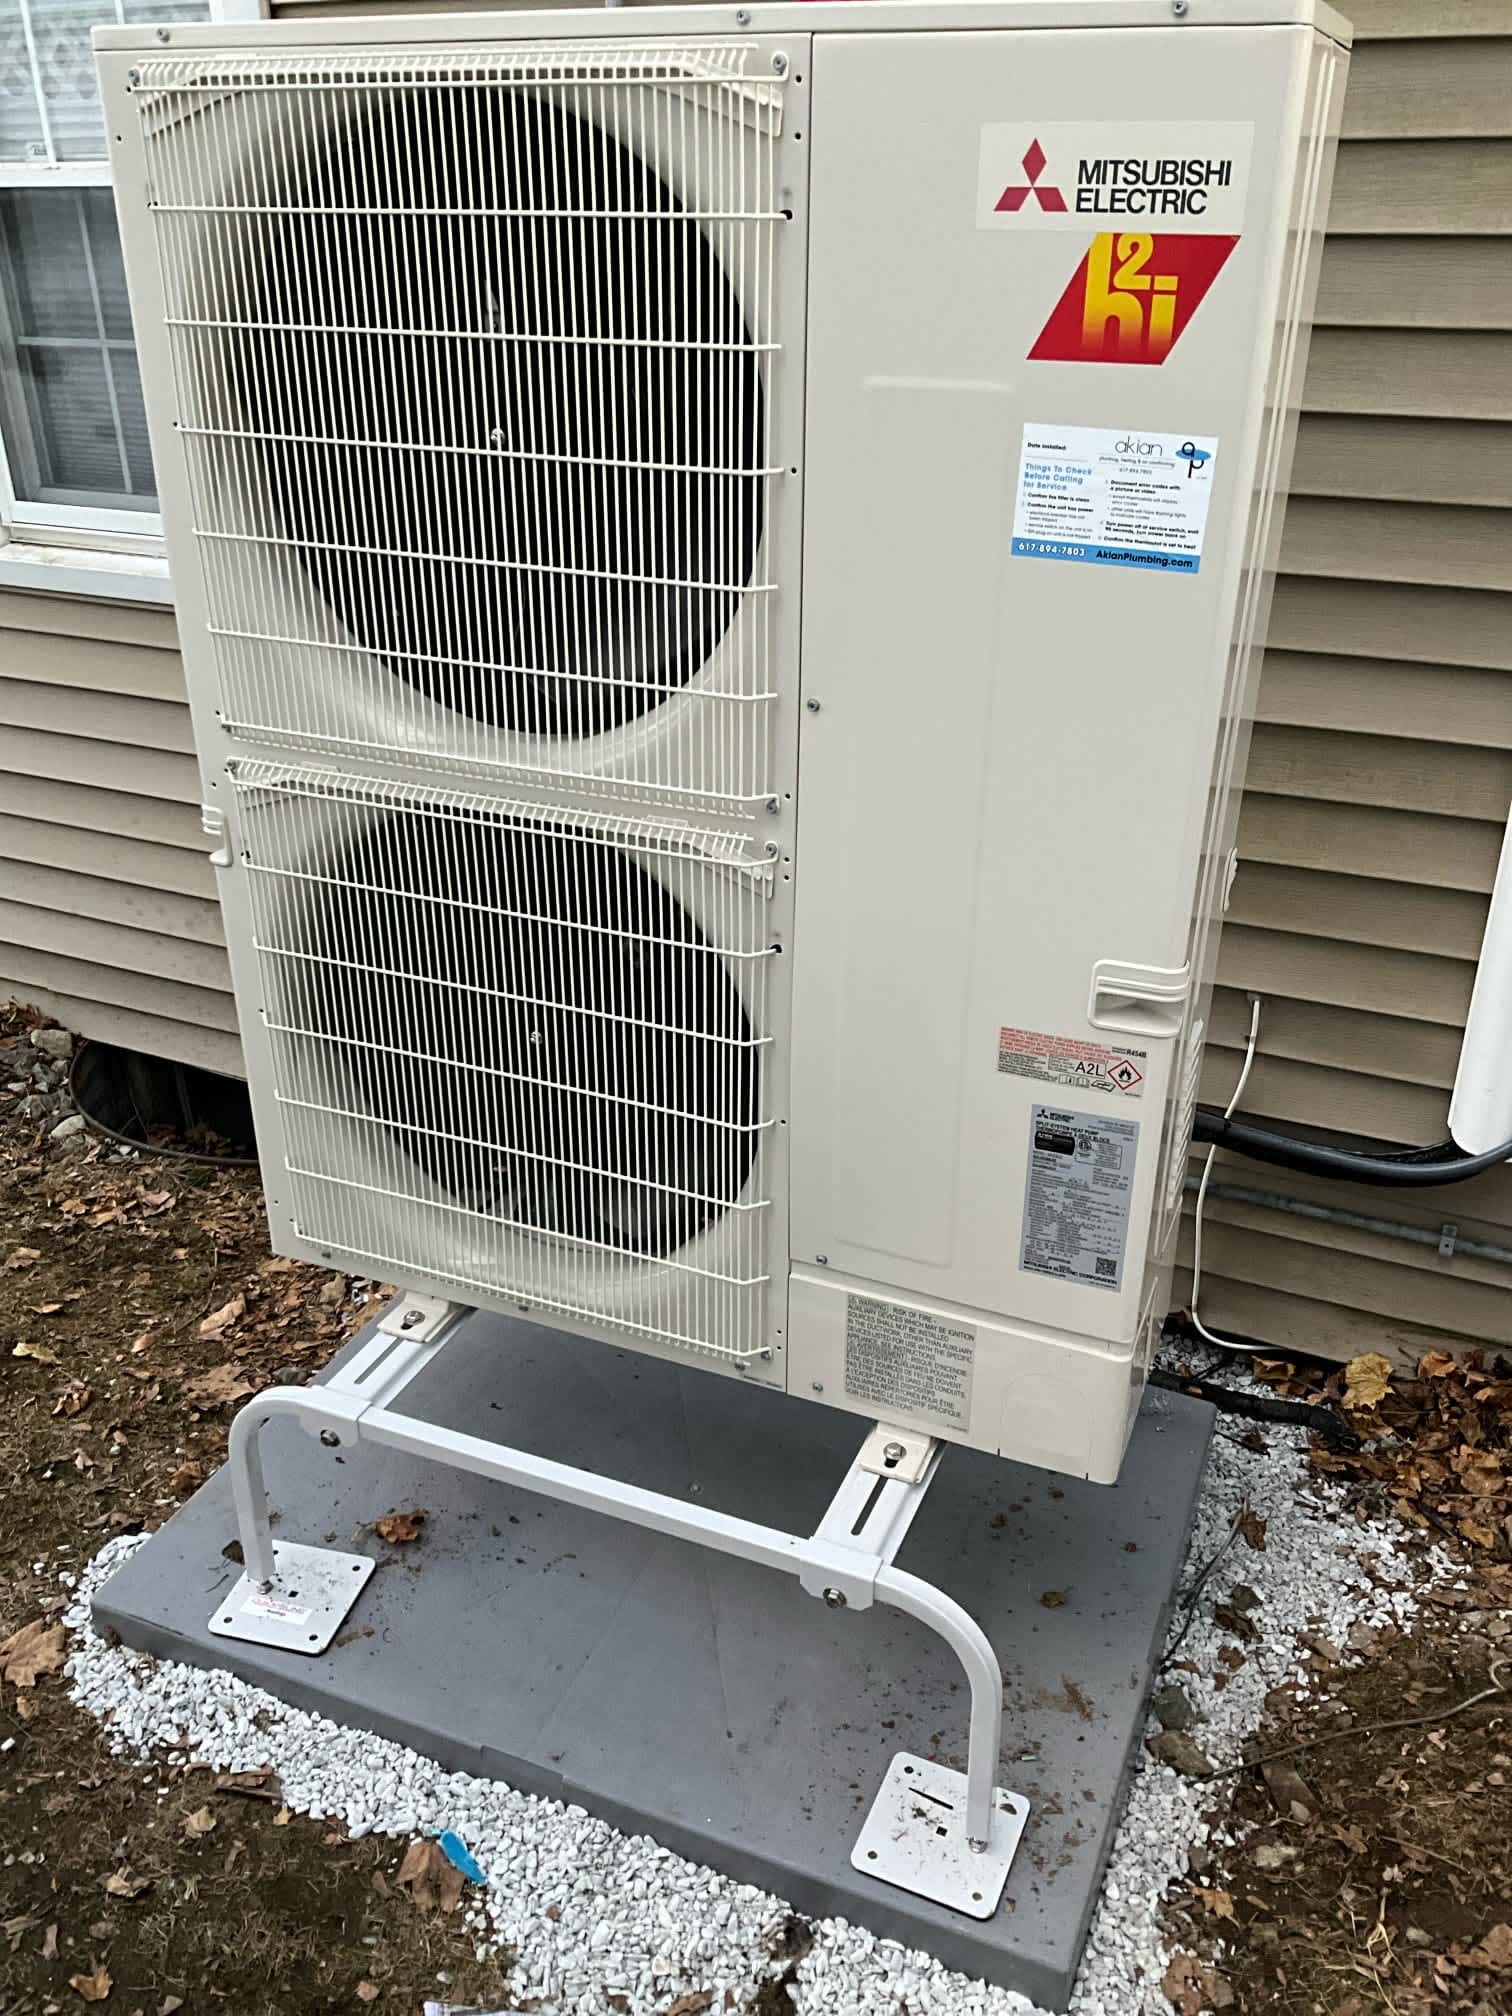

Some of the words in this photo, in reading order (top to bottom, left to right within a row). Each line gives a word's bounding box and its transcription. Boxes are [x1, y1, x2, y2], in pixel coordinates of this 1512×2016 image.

[1077, 159, 1232, 186] MITSUBISHI
[1075, 189, 1208, 215] ELECTRIC
[1115, 435, 1163, 456] akian
[1025, 463, 1051, 473] Things
[1065, 466, 1092, 475] Check
[1024, 471, 1050, 481] Before
[1053, 474, 1083, 485] Calling
[1024, 480, 1034, 488] for
[1037, 481, 1067, 491] Service
[1096, 550, 1193, 568] AkianPlumbing.com
[1075, 1061, 1105, 1078] A2L
